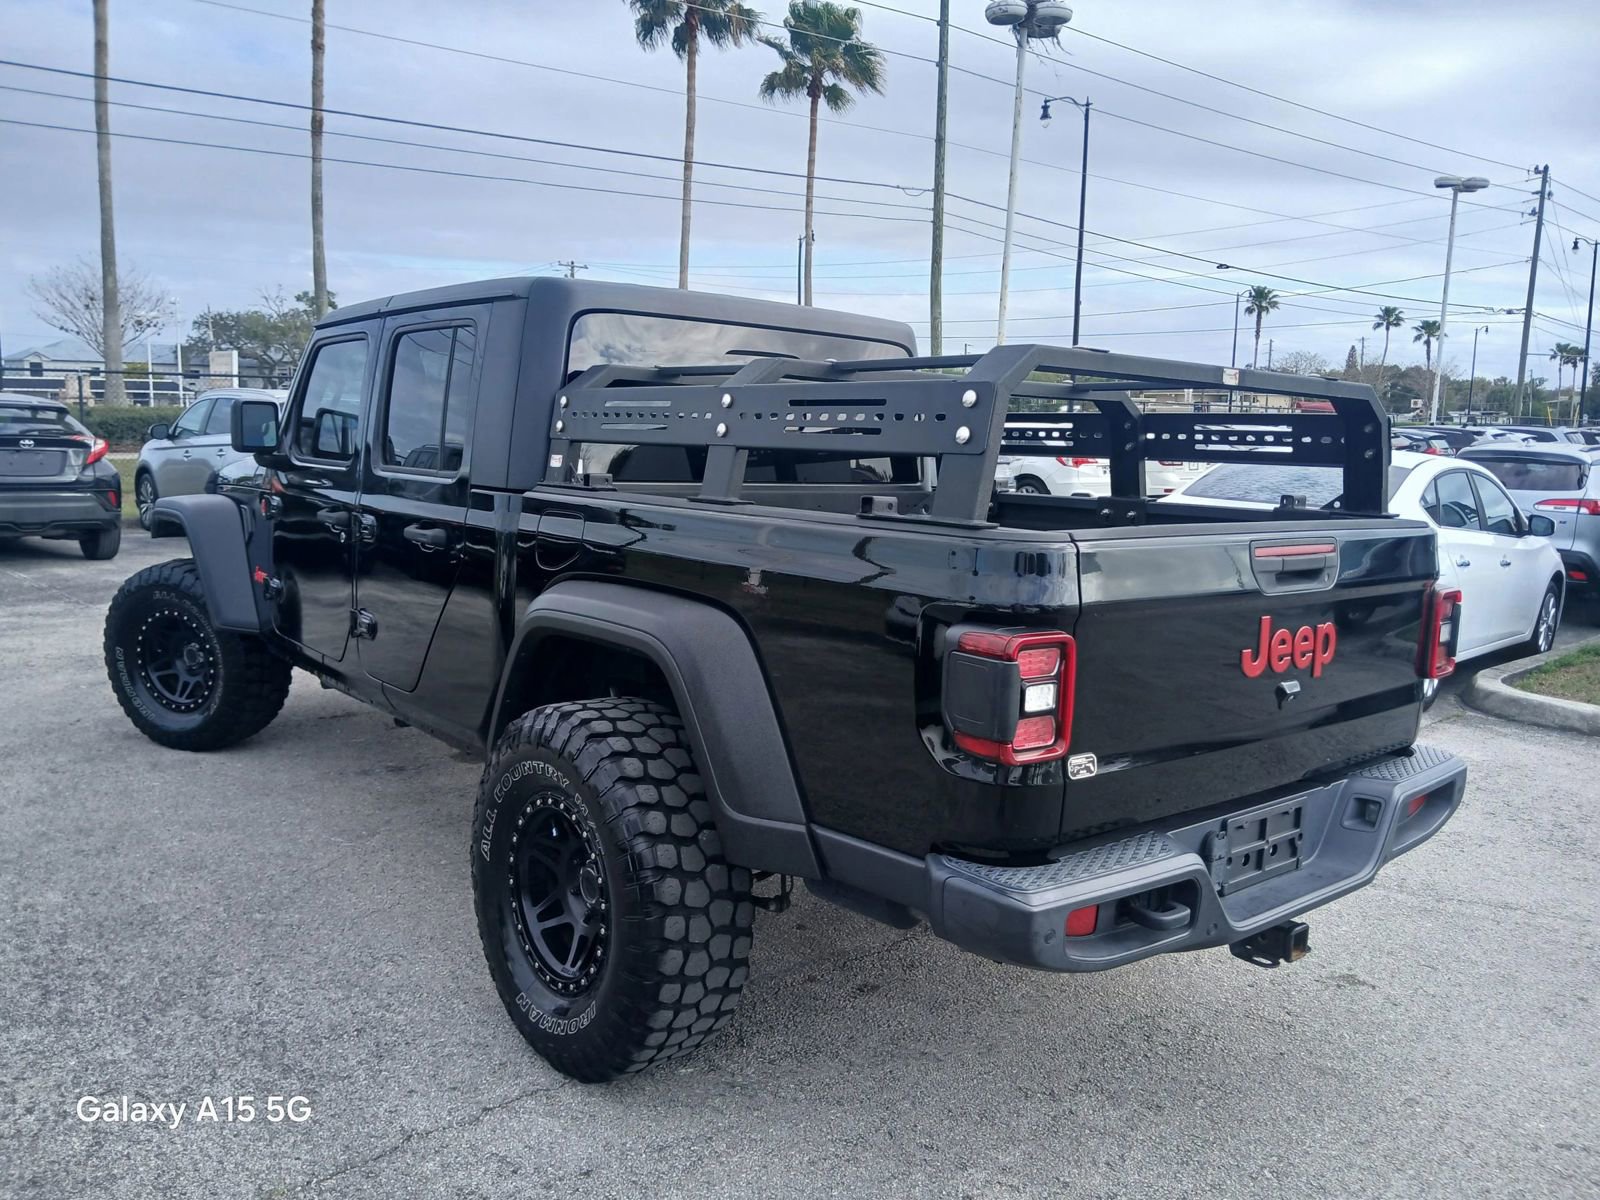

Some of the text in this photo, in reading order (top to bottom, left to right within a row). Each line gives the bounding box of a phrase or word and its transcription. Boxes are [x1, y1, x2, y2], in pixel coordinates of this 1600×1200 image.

[1240, 615, 1337, 678] Jeep
[480, 808, 498, 862] ALL
[493, 760, 570, 803] COUNTRY
[514, 992, 597, 1036] IRONMAN
